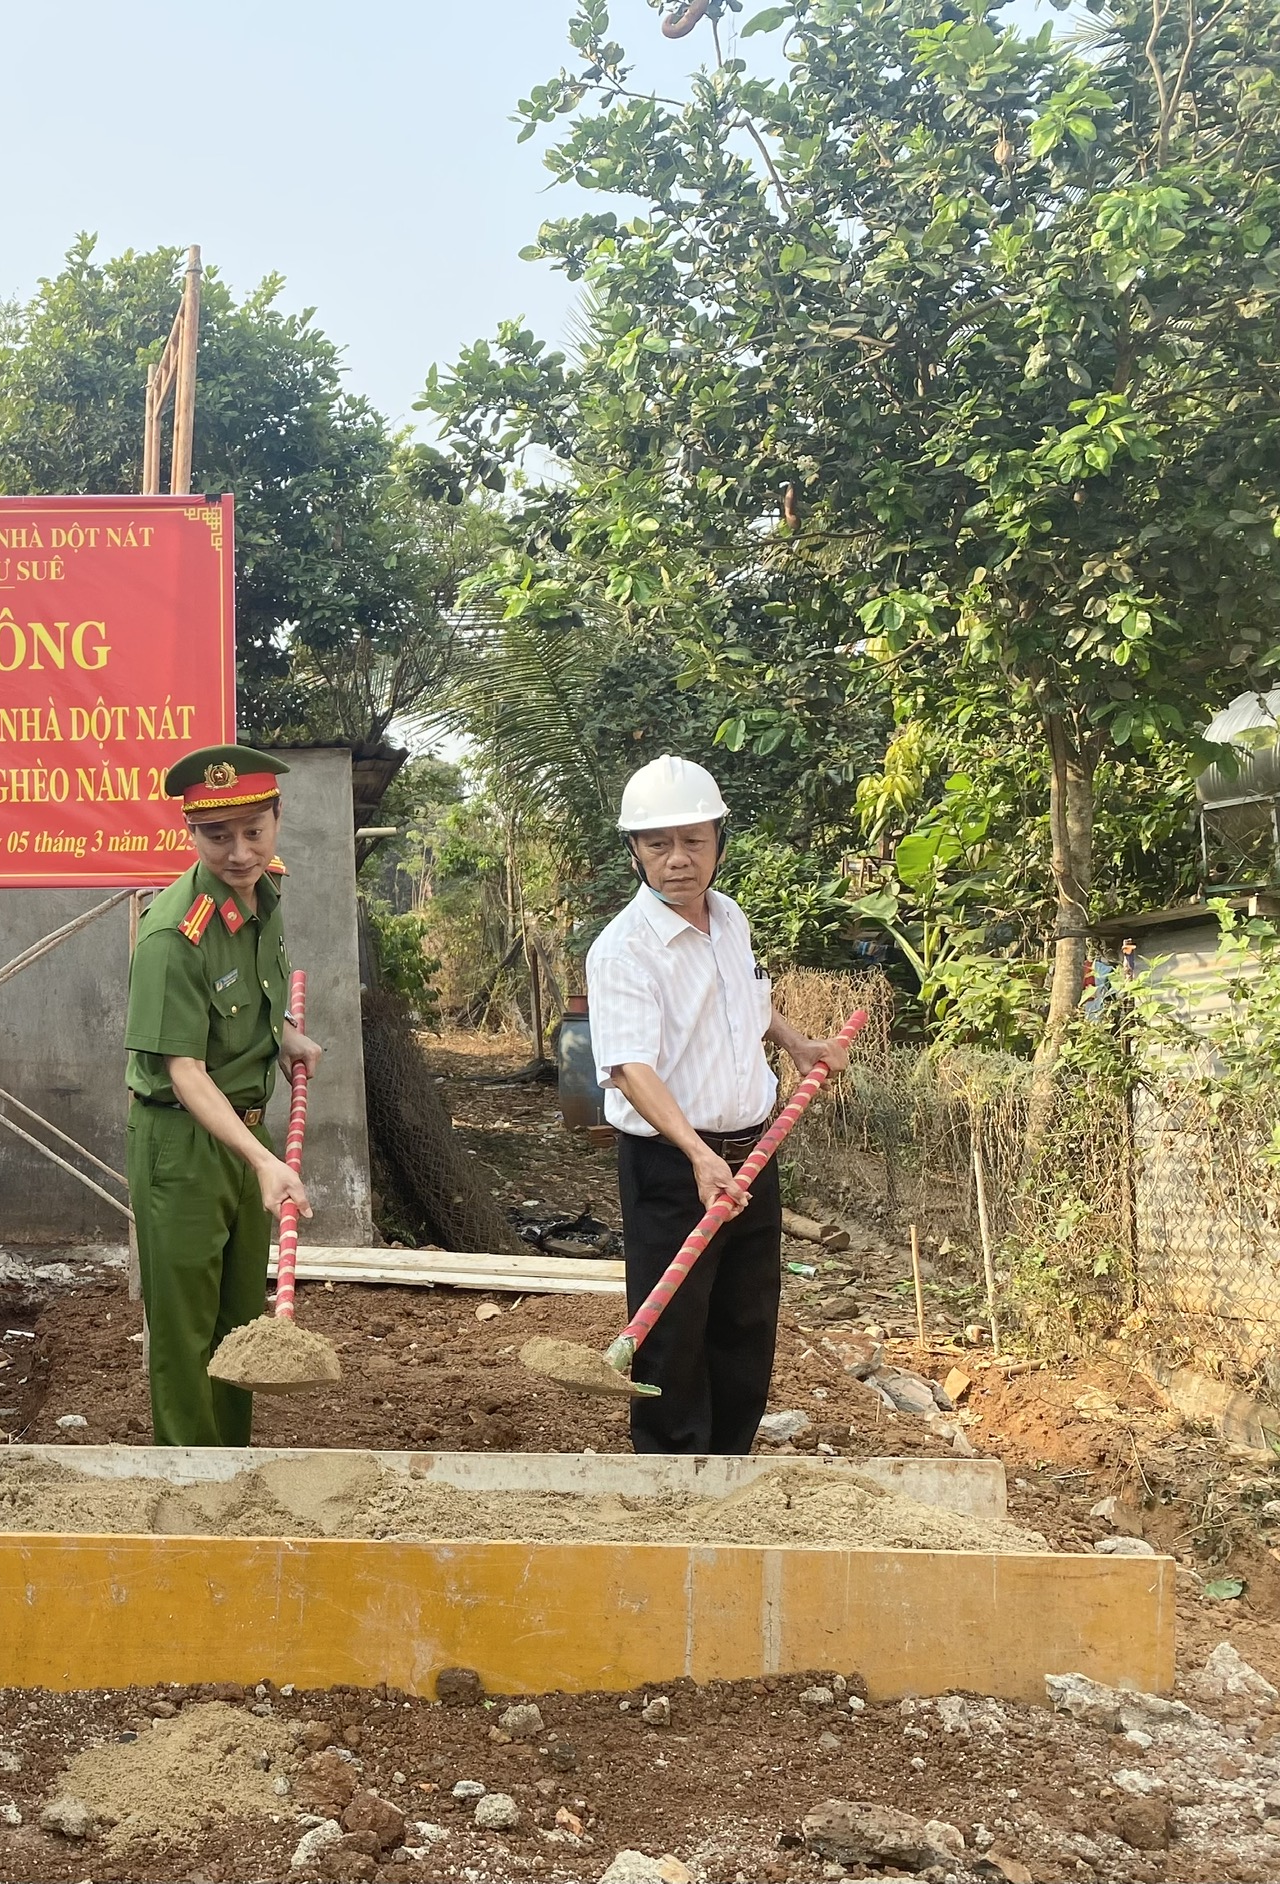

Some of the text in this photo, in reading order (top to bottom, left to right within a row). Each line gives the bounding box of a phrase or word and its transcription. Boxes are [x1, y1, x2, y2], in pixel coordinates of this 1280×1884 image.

[50, 521, 100, 554] DỘT
[105, 521, 154, 548] NÁT
[16, 554, 65, 581] SUÊ
[69, 695, 130, 750] DỘT
[135, 694, 196, 740] NÁT
[75, 759, 141, 802] NĂM
[146, 766, 185, 802] 20
[6, 830, 31, 853] 05
[33, 829, 88, 859] tháng
[90, 829, 104, 852] 3
[106, 829, 150, 852] năm
